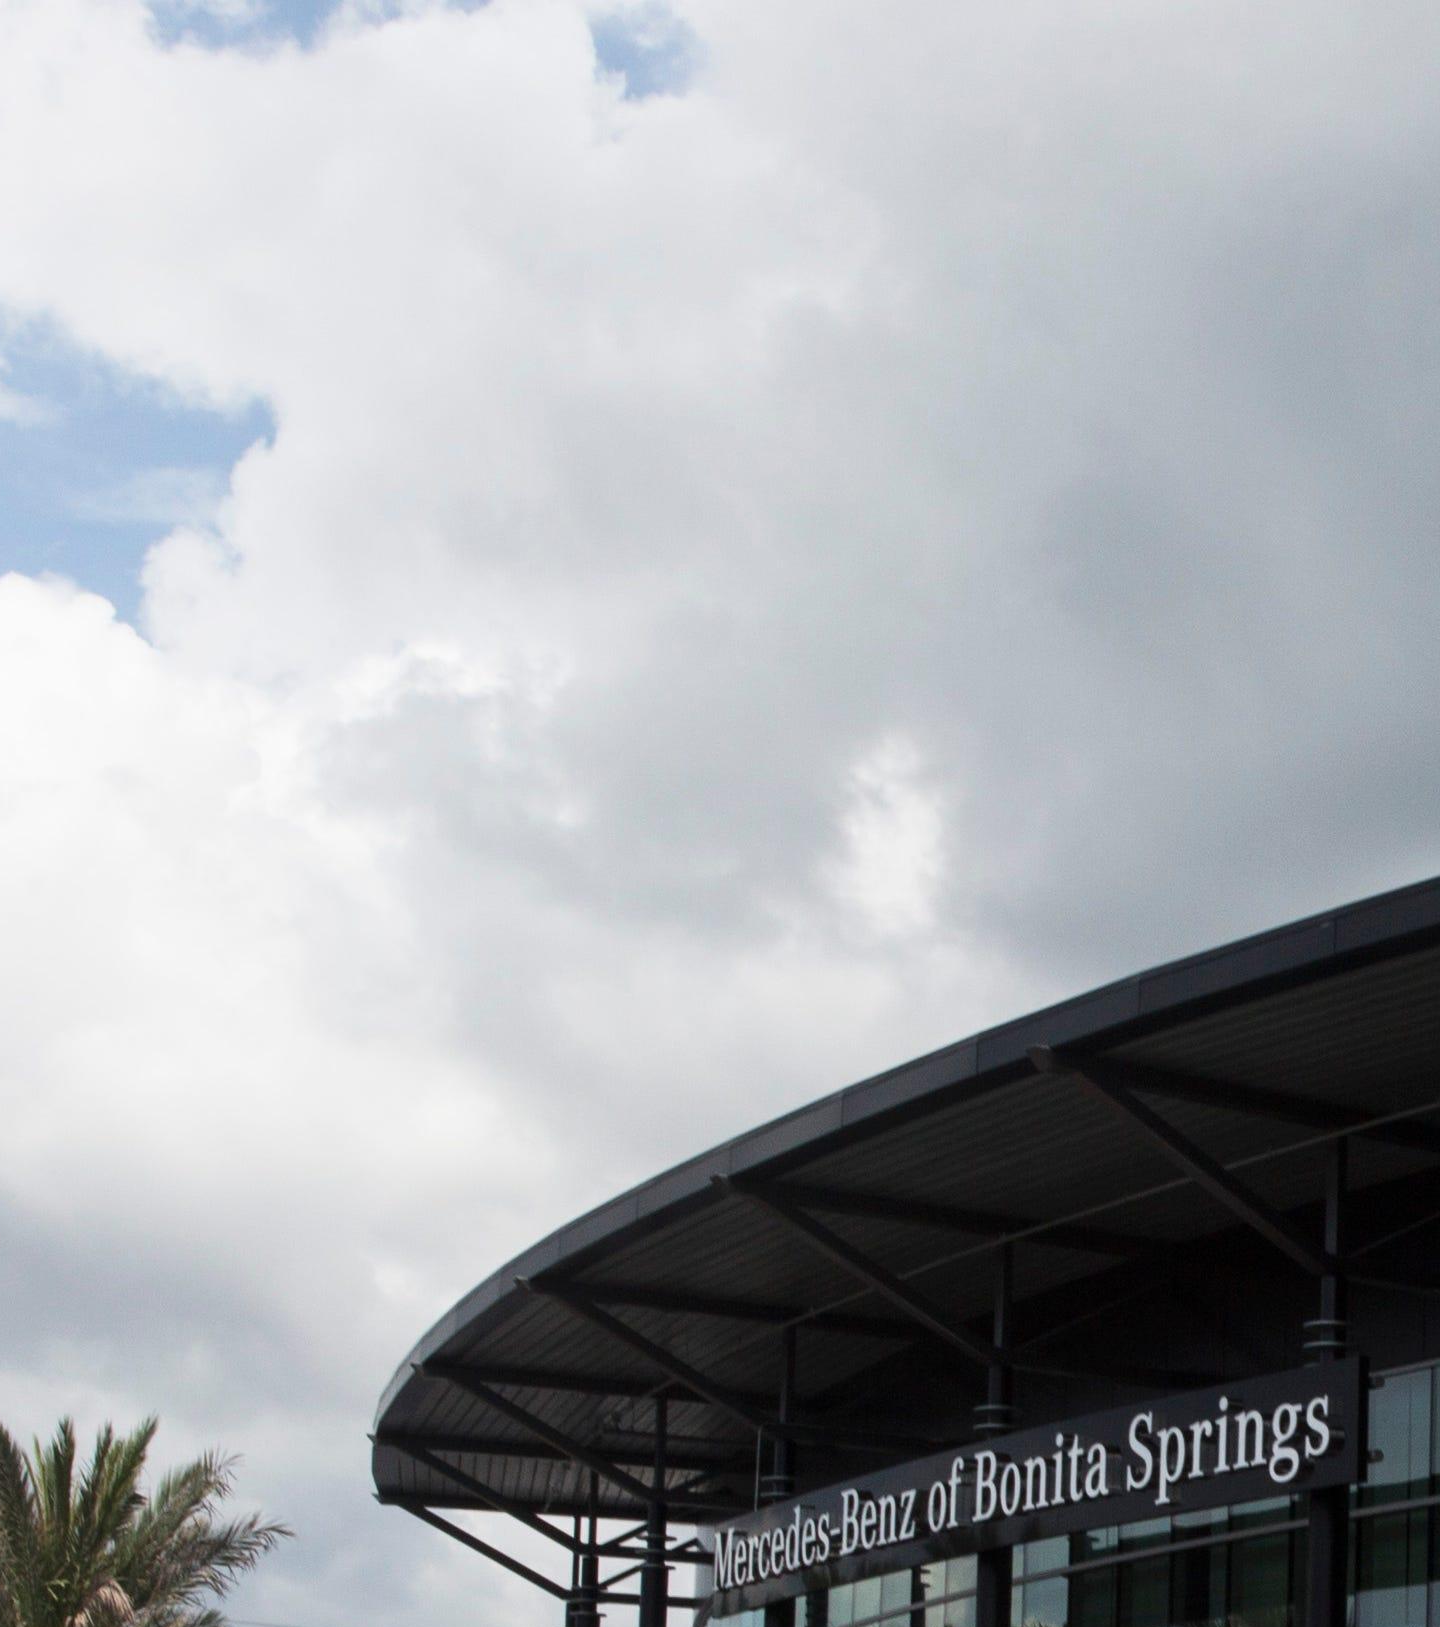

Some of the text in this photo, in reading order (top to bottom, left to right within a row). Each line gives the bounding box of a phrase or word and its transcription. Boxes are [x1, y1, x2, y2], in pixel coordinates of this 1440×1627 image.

[713, 1395, 1329, 1591] Mercedes-Benz of Bonita Springs
